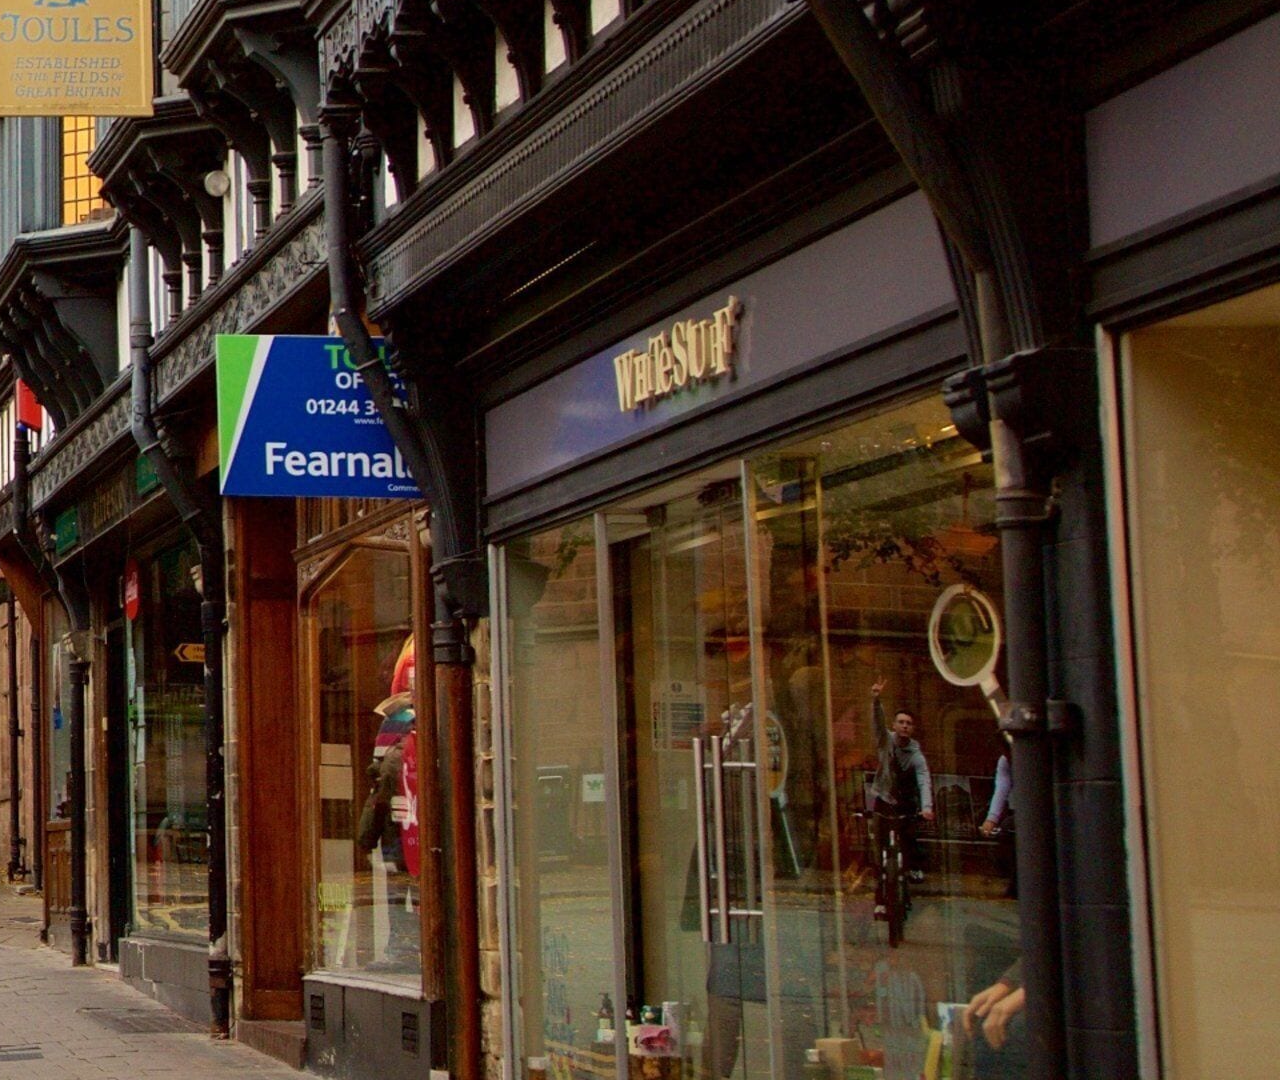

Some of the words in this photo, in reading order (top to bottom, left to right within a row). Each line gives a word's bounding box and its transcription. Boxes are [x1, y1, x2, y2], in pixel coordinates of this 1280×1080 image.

[0, 13, 135, 43] JOULES
[15, 56, 122, 69] ESTABLISHED
[10, 73, 24, 82] IN
[28, 73, 49, 82] THE
[53, 71, 110, 83] FIELDS
[111, 74, 125, 82] OF
[15, 85, 60, 98] GREAT
[65, 86, 122, 97] BRITAIN
[306, 399, 360, 414] 01244
[265, 442, 413, 477] Fearnal
